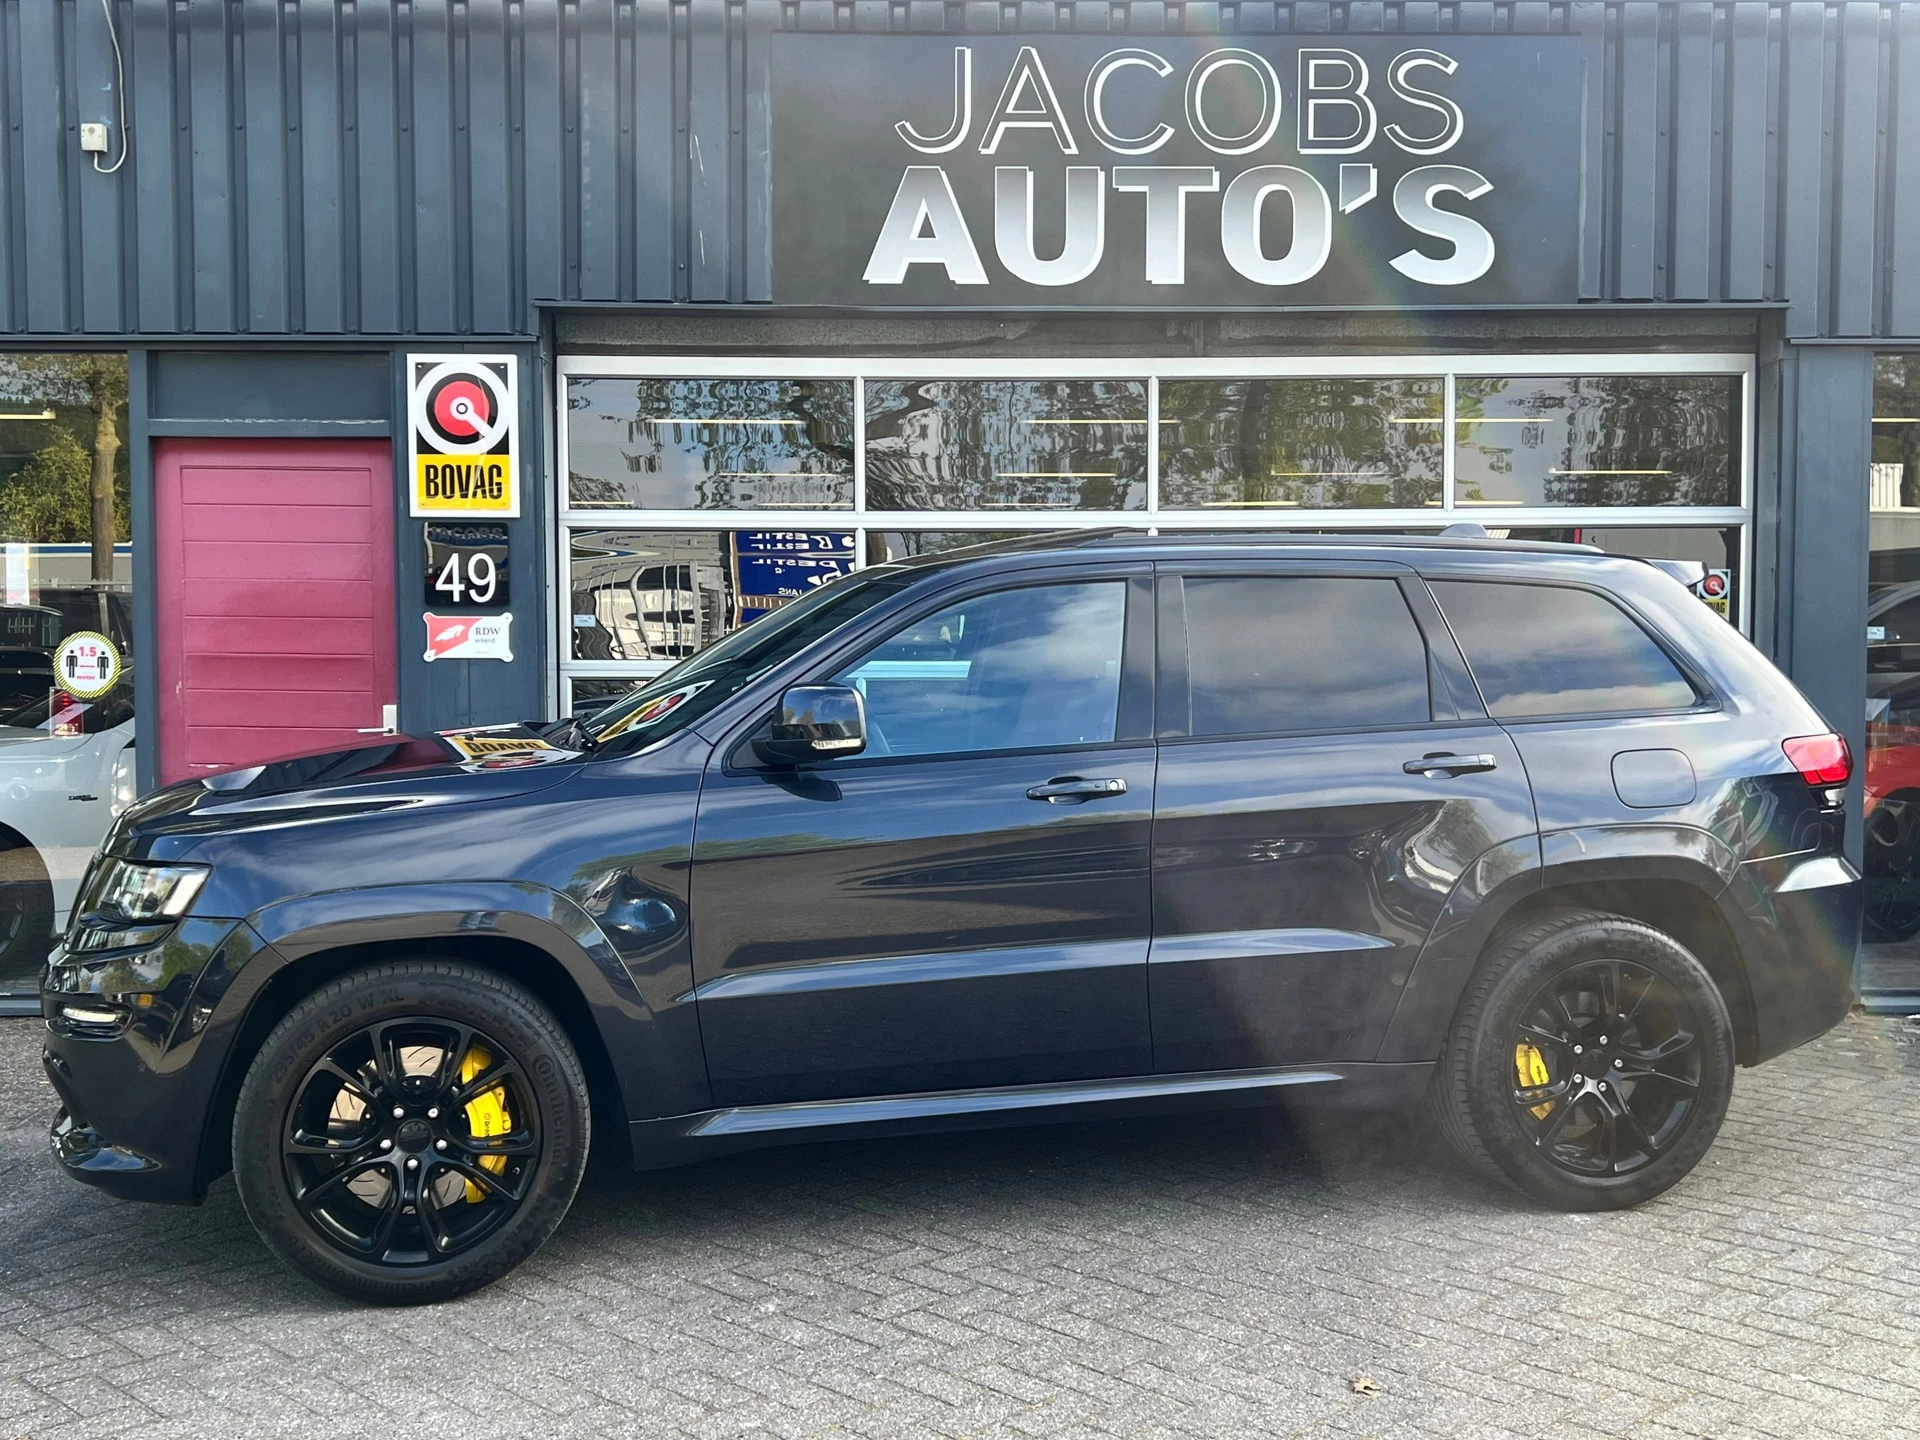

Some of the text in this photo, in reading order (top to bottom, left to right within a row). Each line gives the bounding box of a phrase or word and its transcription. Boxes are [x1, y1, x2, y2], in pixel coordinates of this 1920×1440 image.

[894, 46, 1465, 155] JACOBS
[862, 163, 1495, 287] AUTO'S
[425, 464, 503, 500] BOVAG
[435, 553, 496, 603] 49
[79, 646, 97, 657] 1.5
[475, 627, 500, 636] RDW
